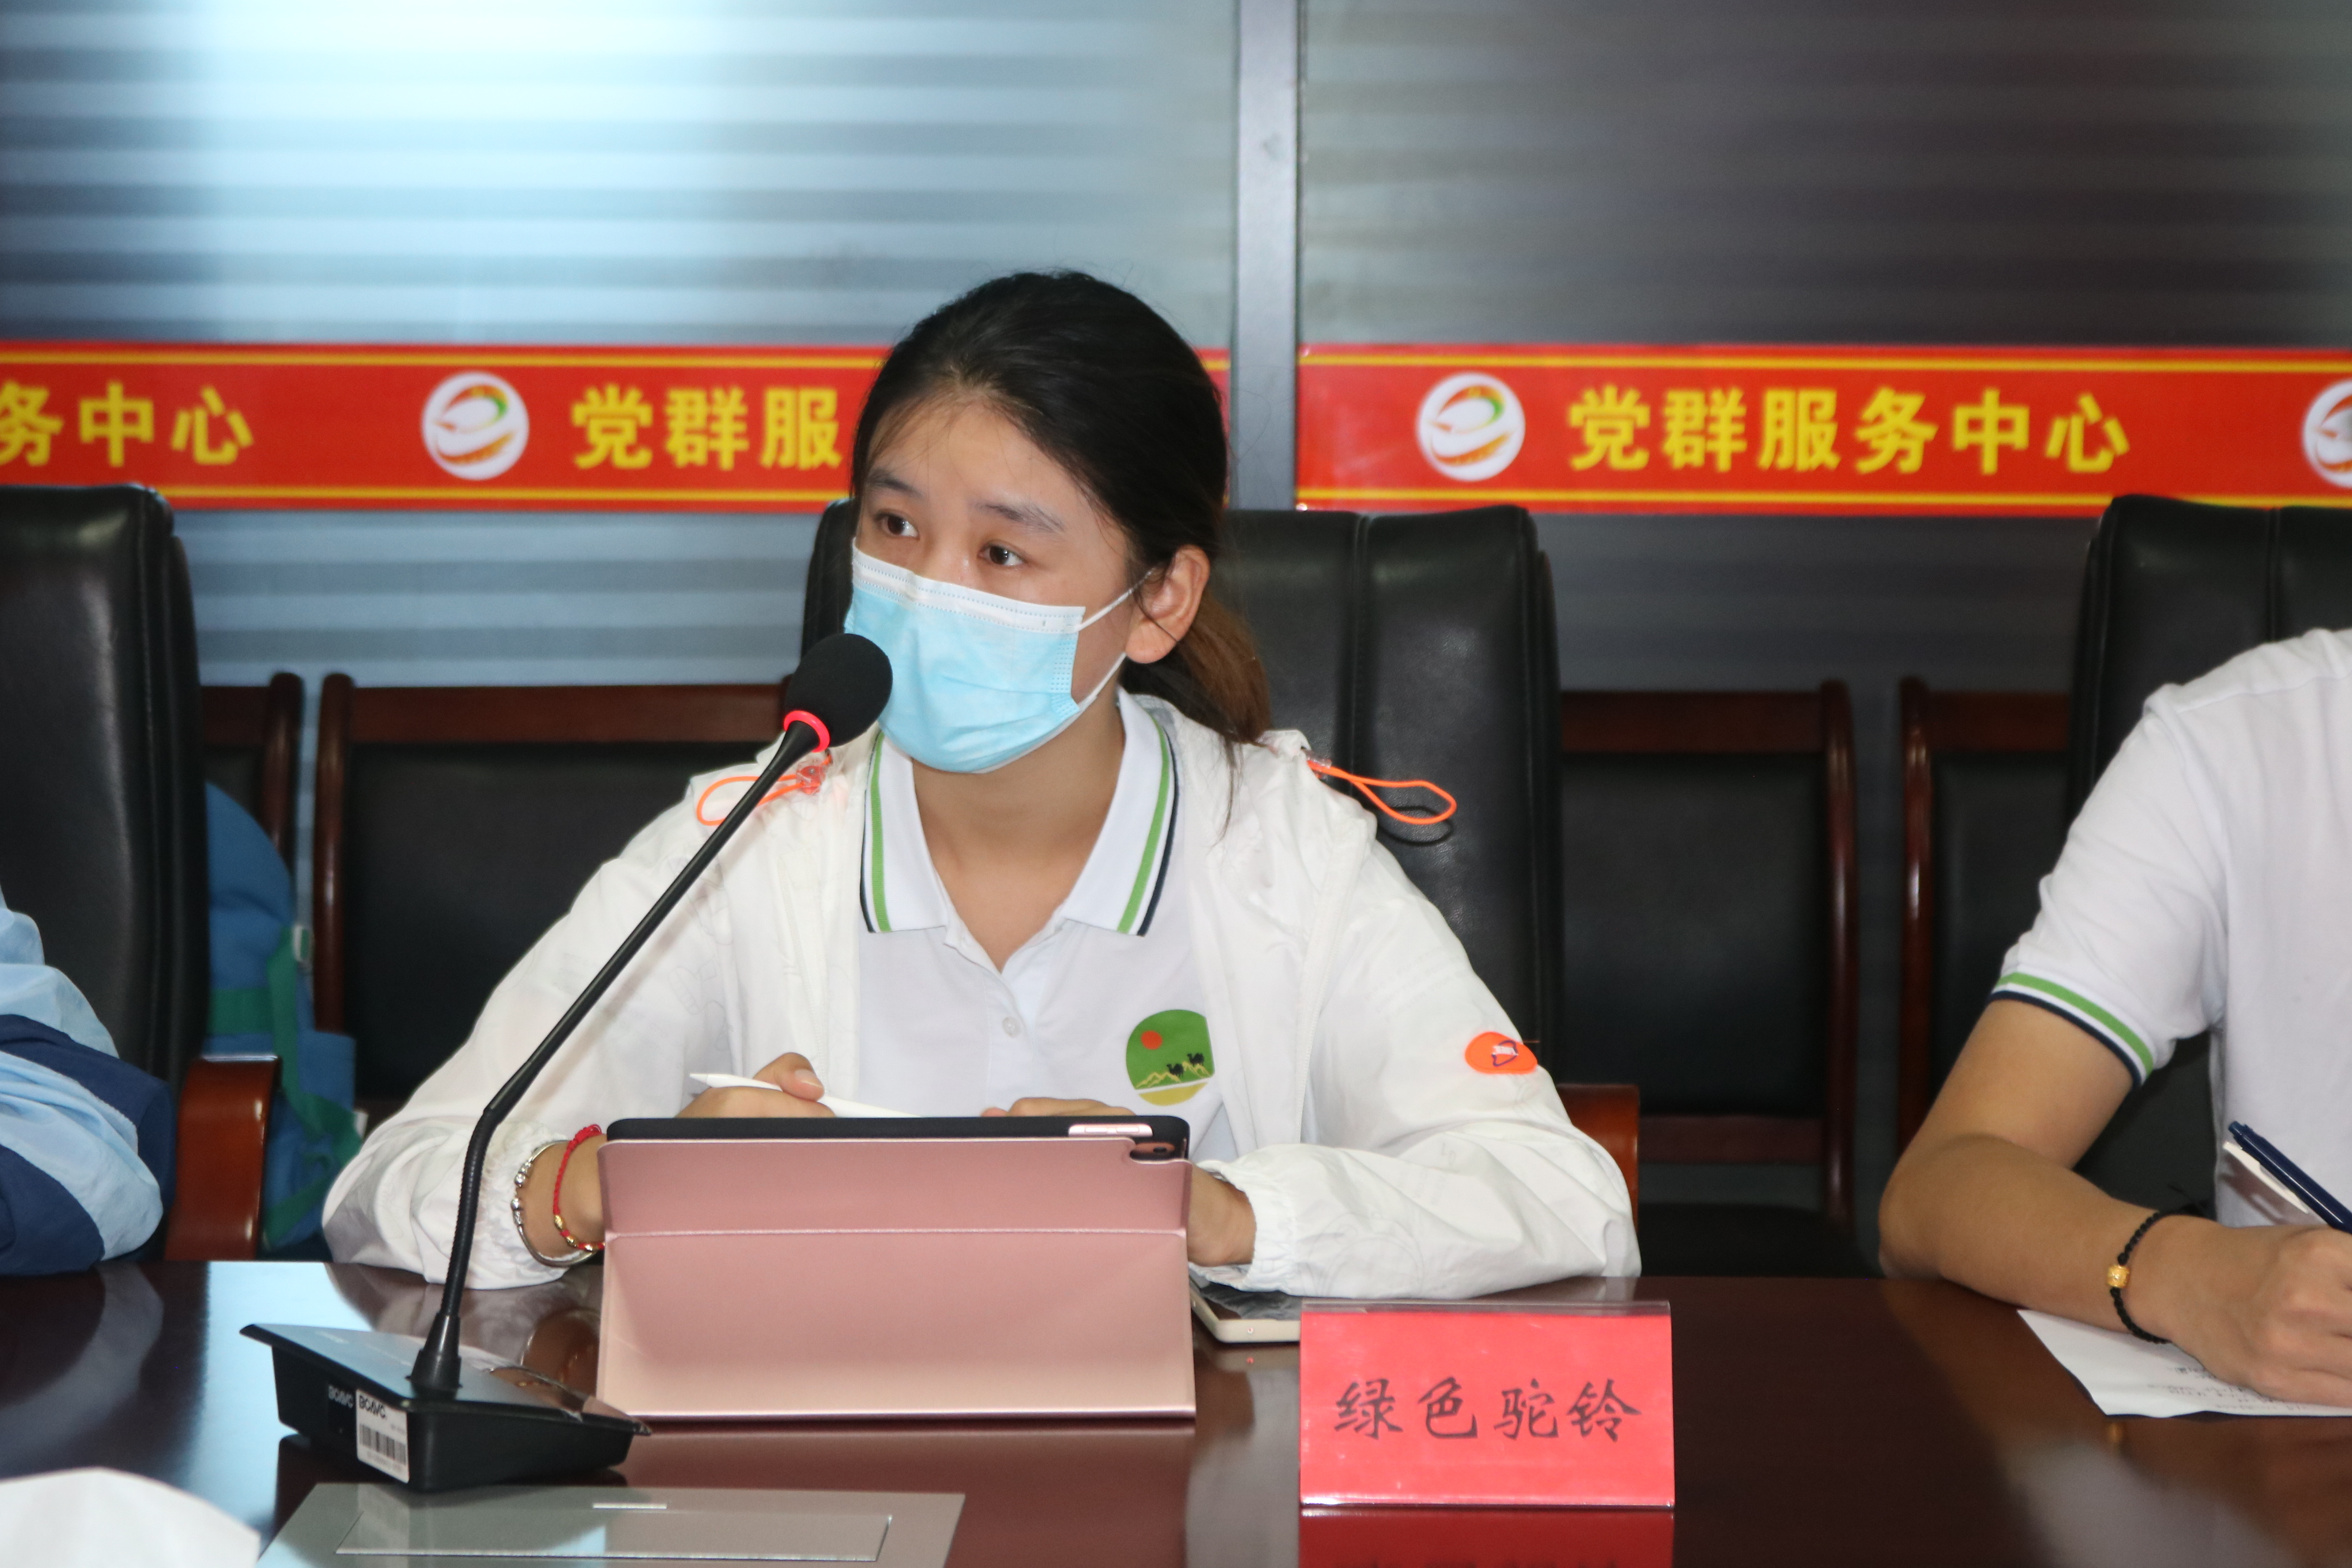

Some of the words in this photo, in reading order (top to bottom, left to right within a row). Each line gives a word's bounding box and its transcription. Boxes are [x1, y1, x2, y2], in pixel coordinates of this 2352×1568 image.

[0, 383, 252, 465] 务中心
[571, 384, 842, 470] 党群服
[1566, 384, 2128, 473] 党群服务中心
[1334, 1375, 1642, 1442] 绿色驼铃
